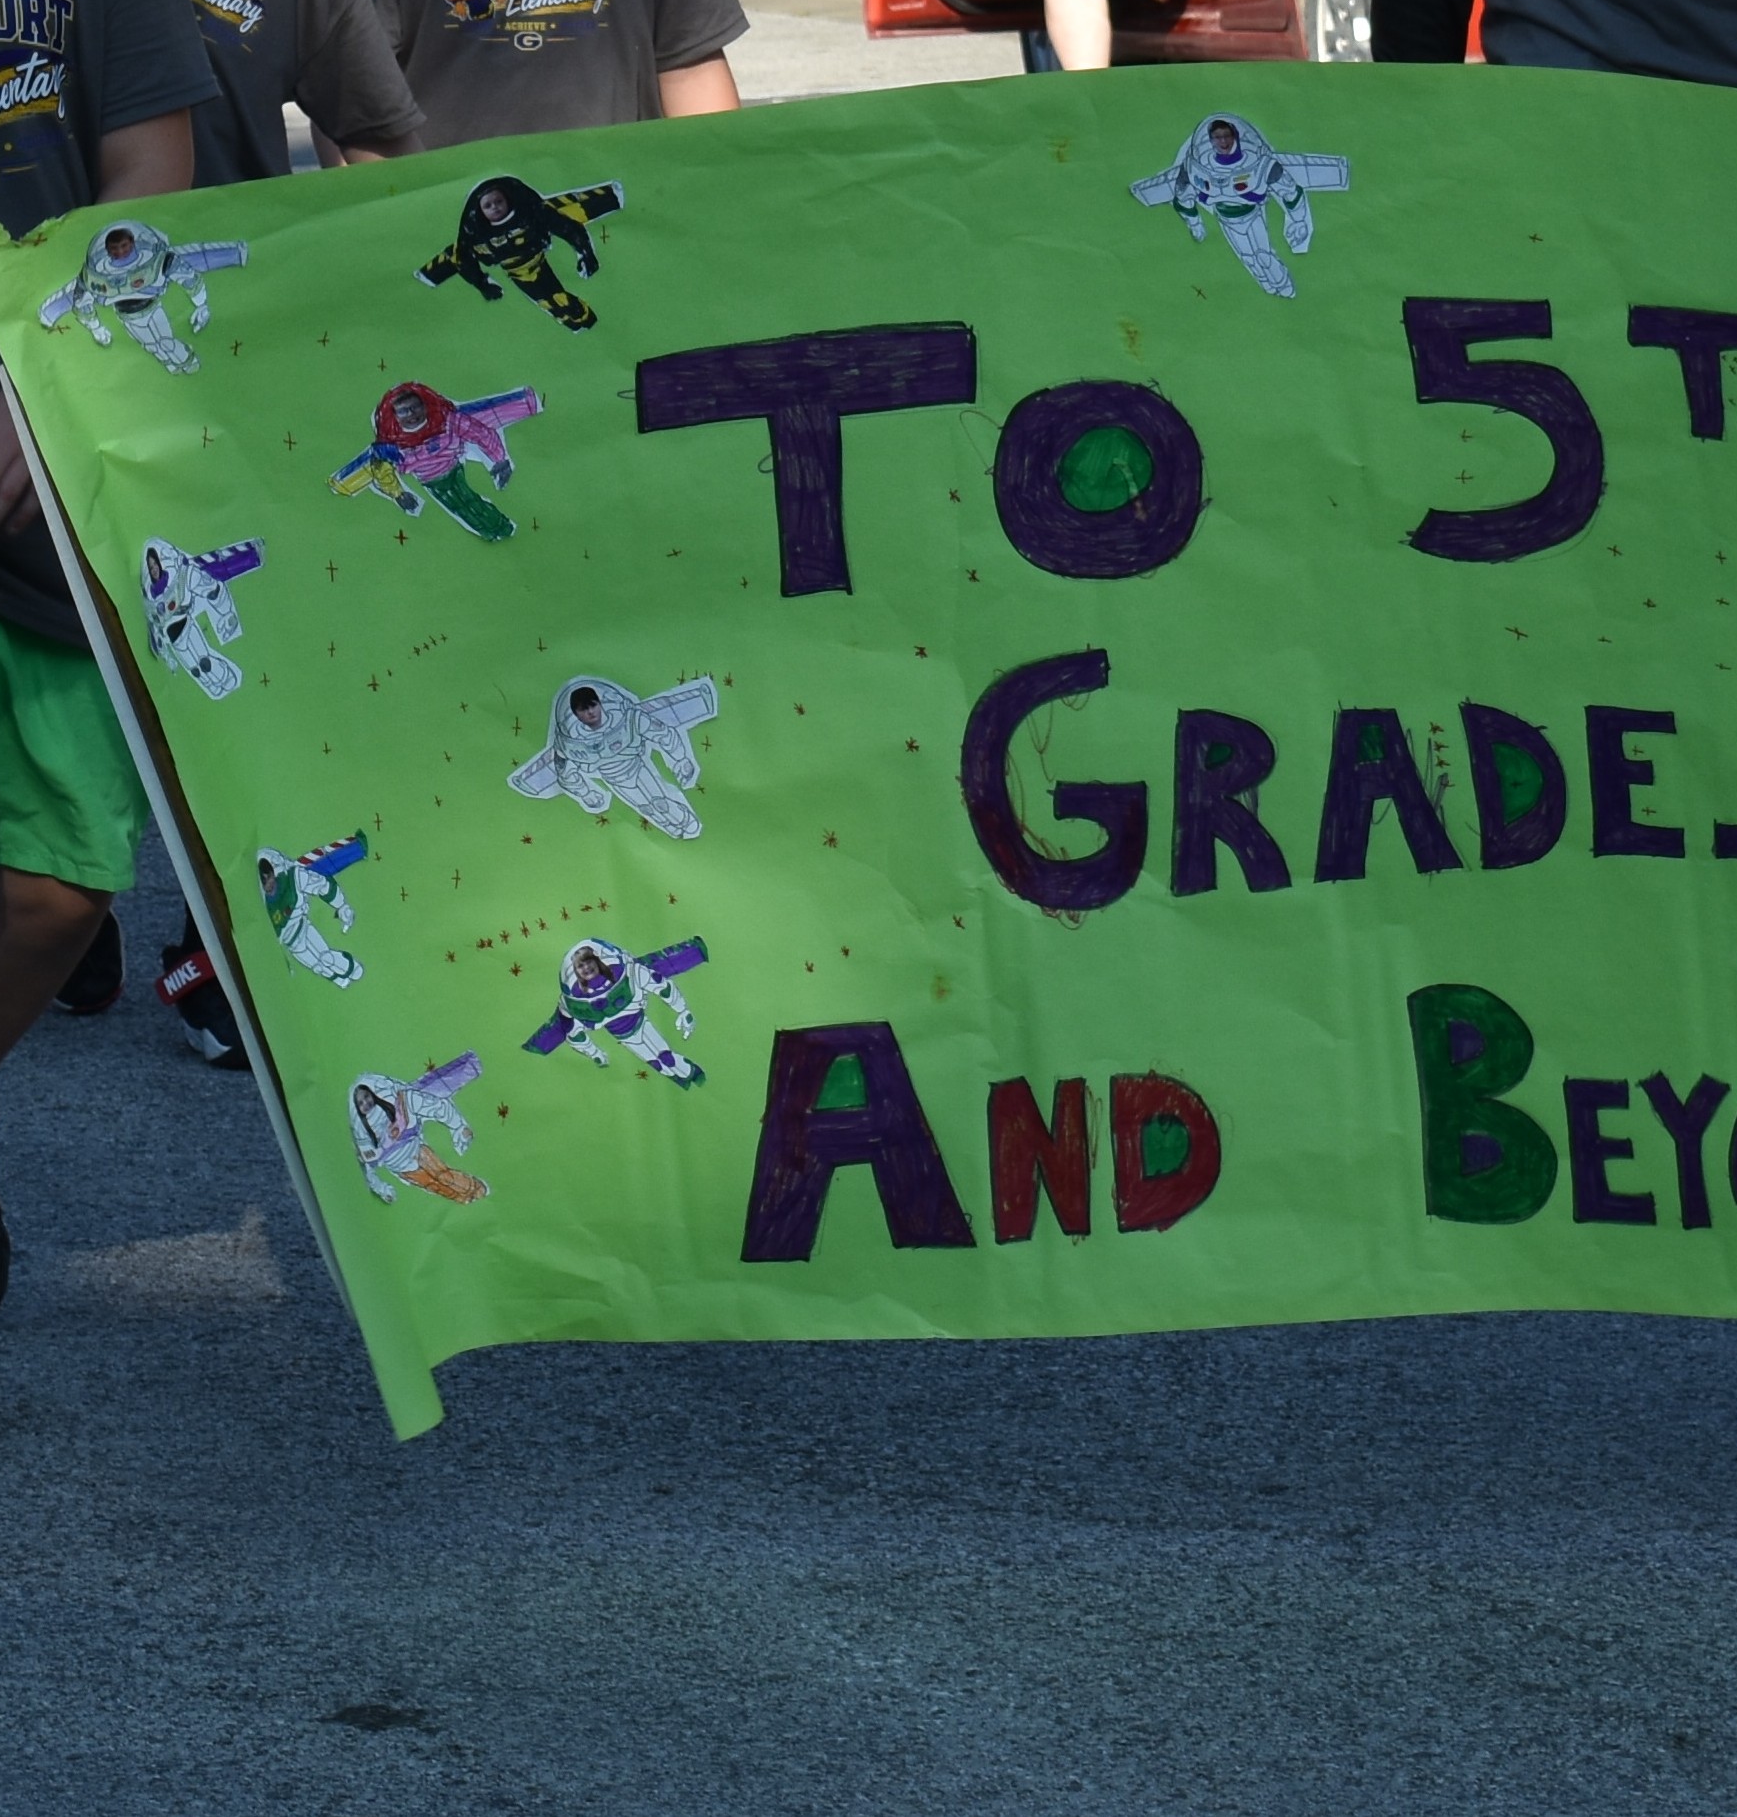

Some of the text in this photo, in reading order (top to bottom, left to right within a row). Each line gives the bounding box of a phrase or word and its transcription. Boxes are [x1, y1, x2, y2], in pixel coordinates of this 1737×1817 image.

[514, 32, 543, 51] G
[637, 321, 1204, 597] TO
[163, 960, 202, 996] NIKE
[740, 1021, 1221, 1263] AND
